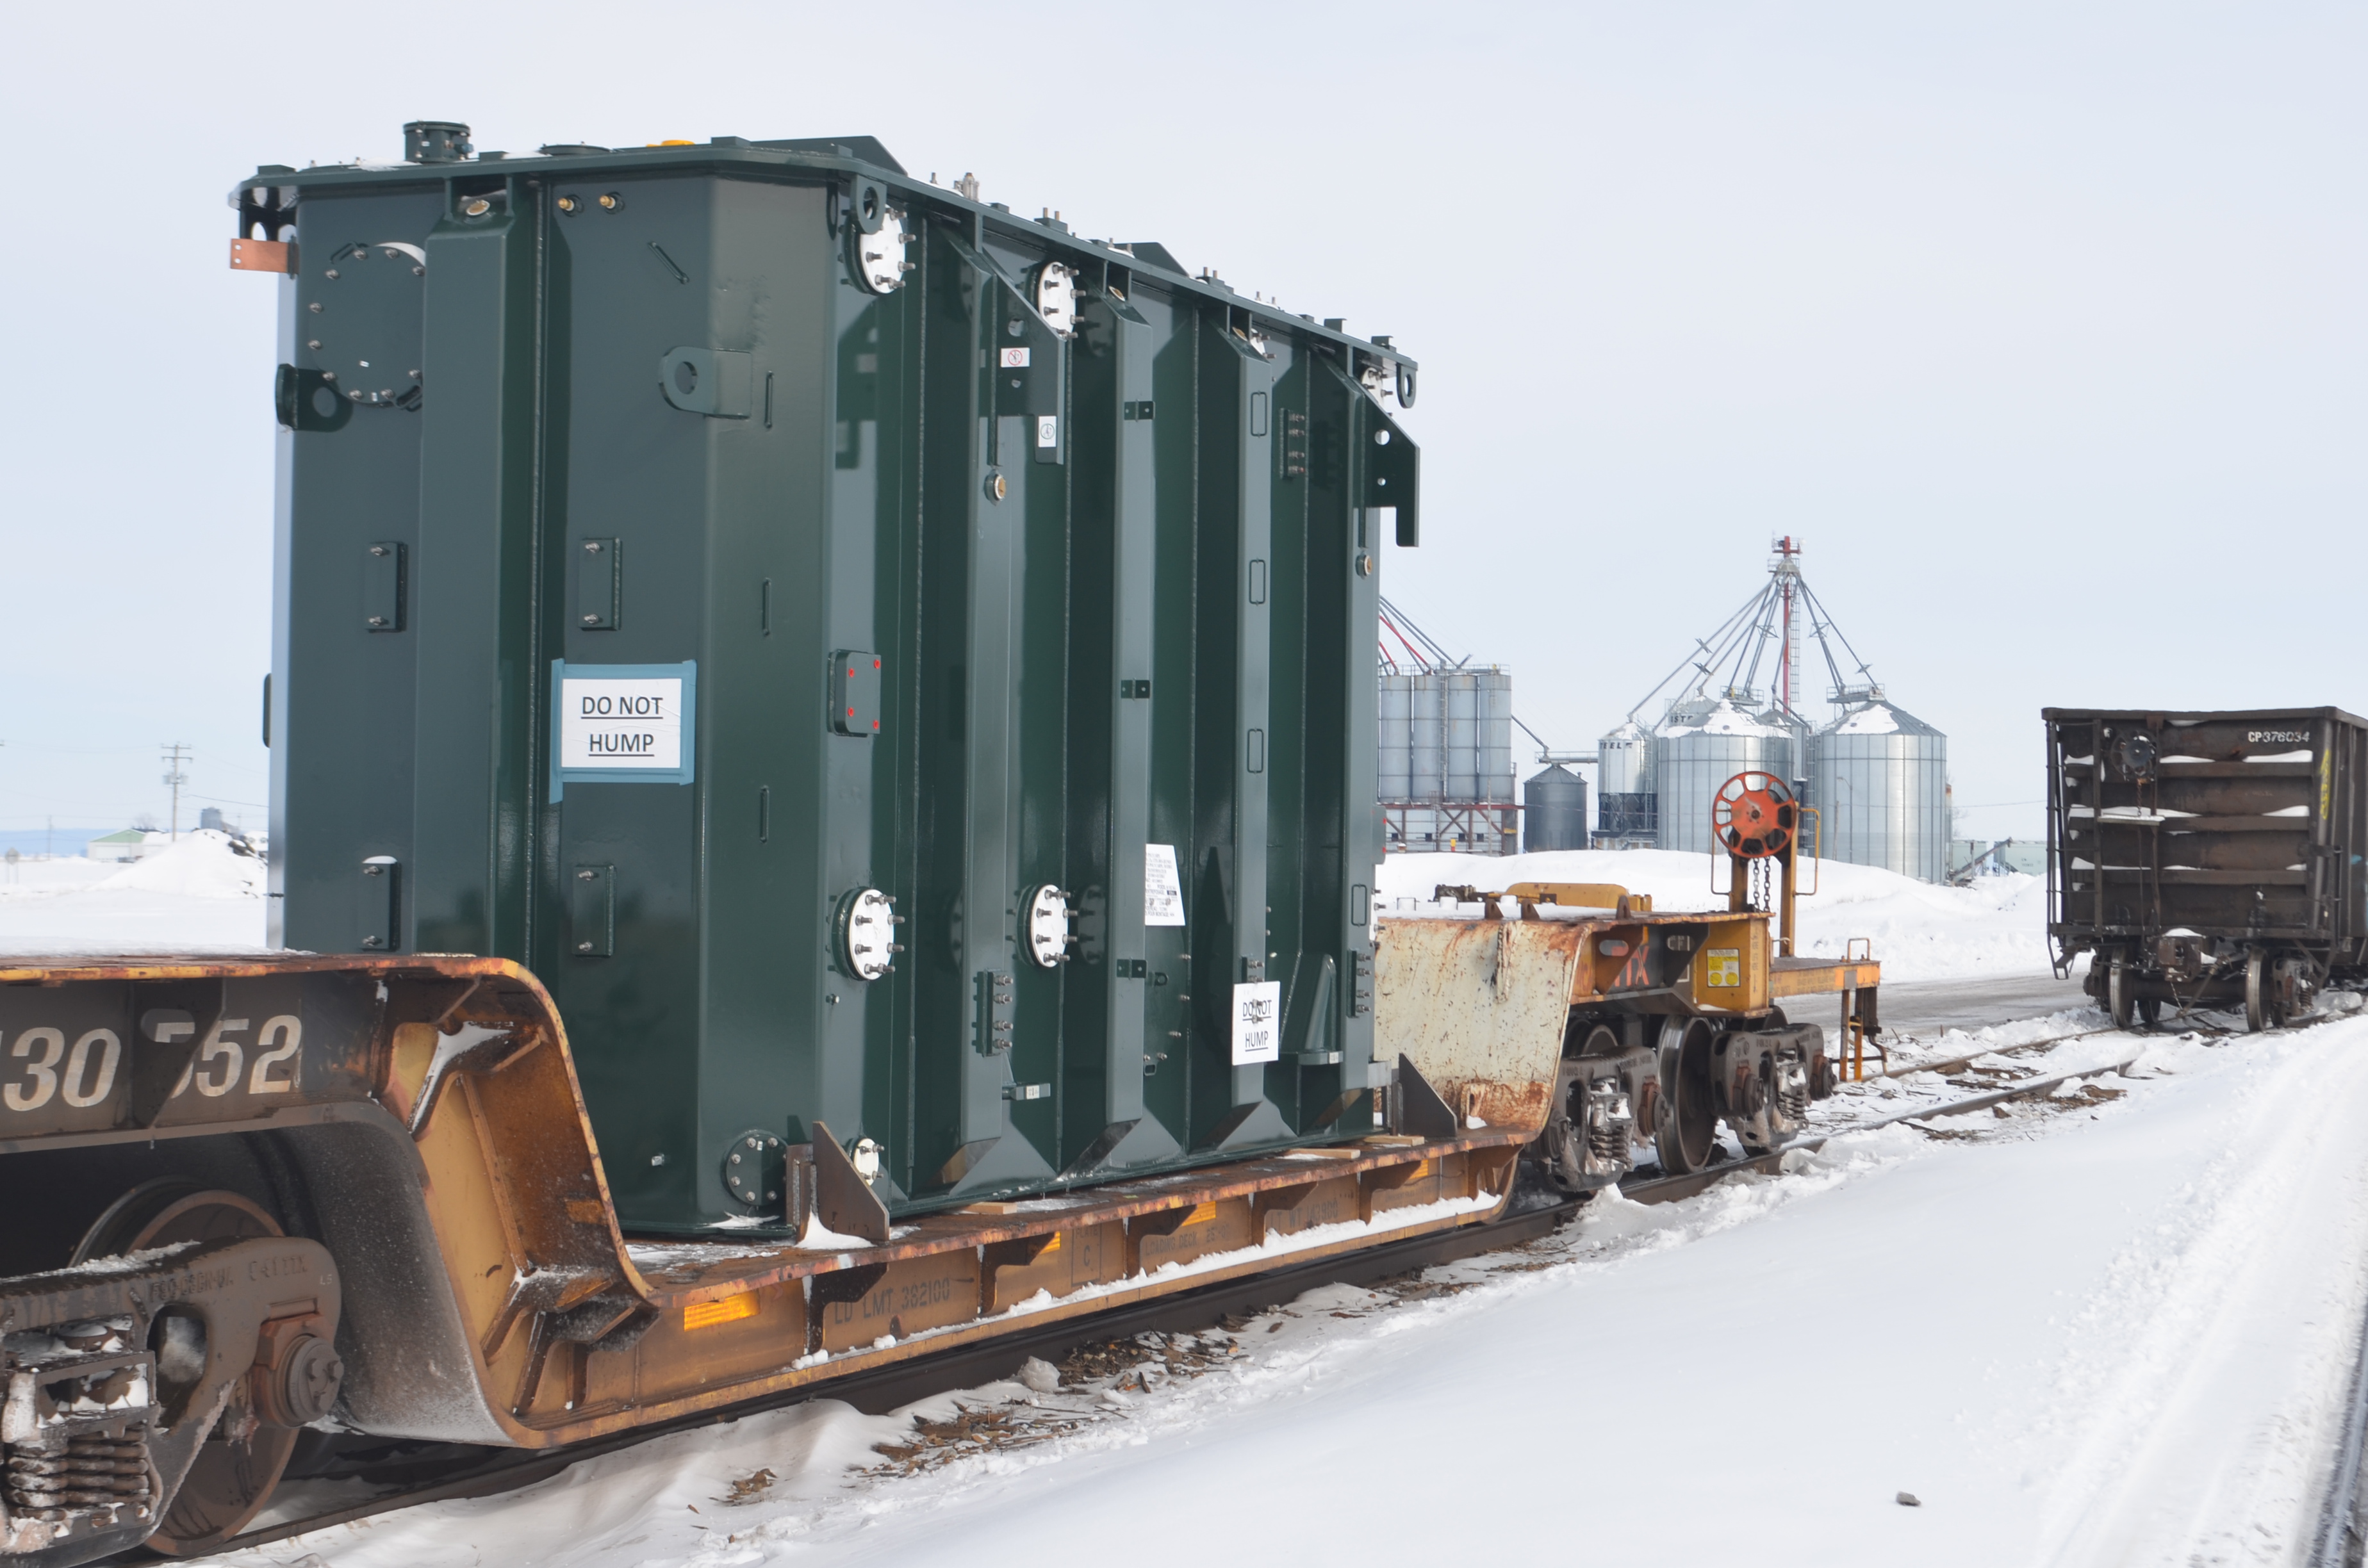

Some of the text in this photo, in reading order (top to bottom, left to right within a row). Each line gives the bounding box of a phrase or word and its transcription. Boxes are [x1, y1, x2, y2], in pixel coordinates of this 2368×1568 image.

[582, 696, 664, 715] DO NOT
[589, 734, 654, 752] HUMP
[1242, 999, 1272, 1017] DO NOT
[1245, 1030, 1269, 1048] HUMP
[0, 1015, 302, 1112] 3052
[1144, 1237, 1176, 1257] LOADING
[1178, 1231, 1198, 1250] DECK
[1083, 1245, 1090, 1267] C
[834, 1301, 853, 1325] LD
[863, 1288, 894, 1319] LMT
